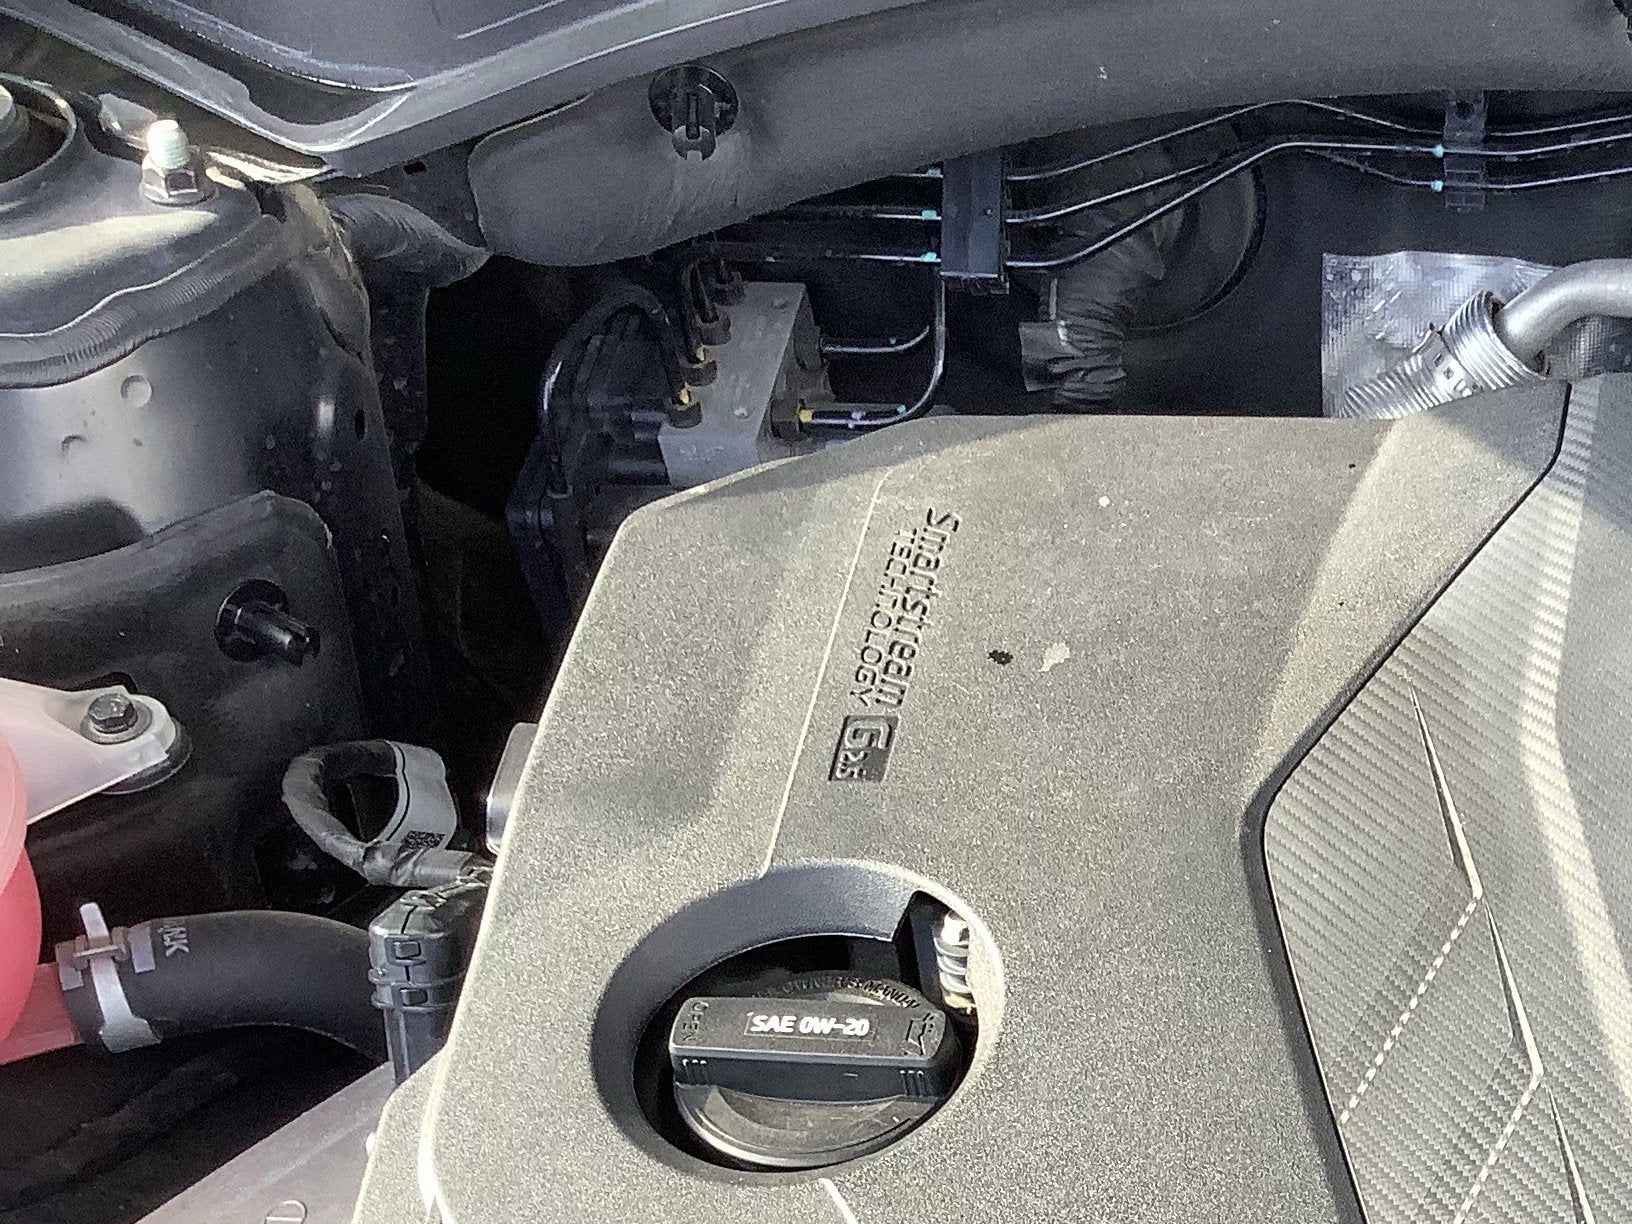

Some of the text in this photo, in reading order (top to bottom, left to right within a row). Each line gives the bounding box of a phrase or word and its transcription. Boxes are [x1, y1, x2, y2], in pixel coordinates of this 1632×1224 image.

[850, 527, 917, 707] TECHNOLOGY
[876, 507, 961, 705] Smartstream
[750, 1014, 870, 1037] SAE 0W-20
